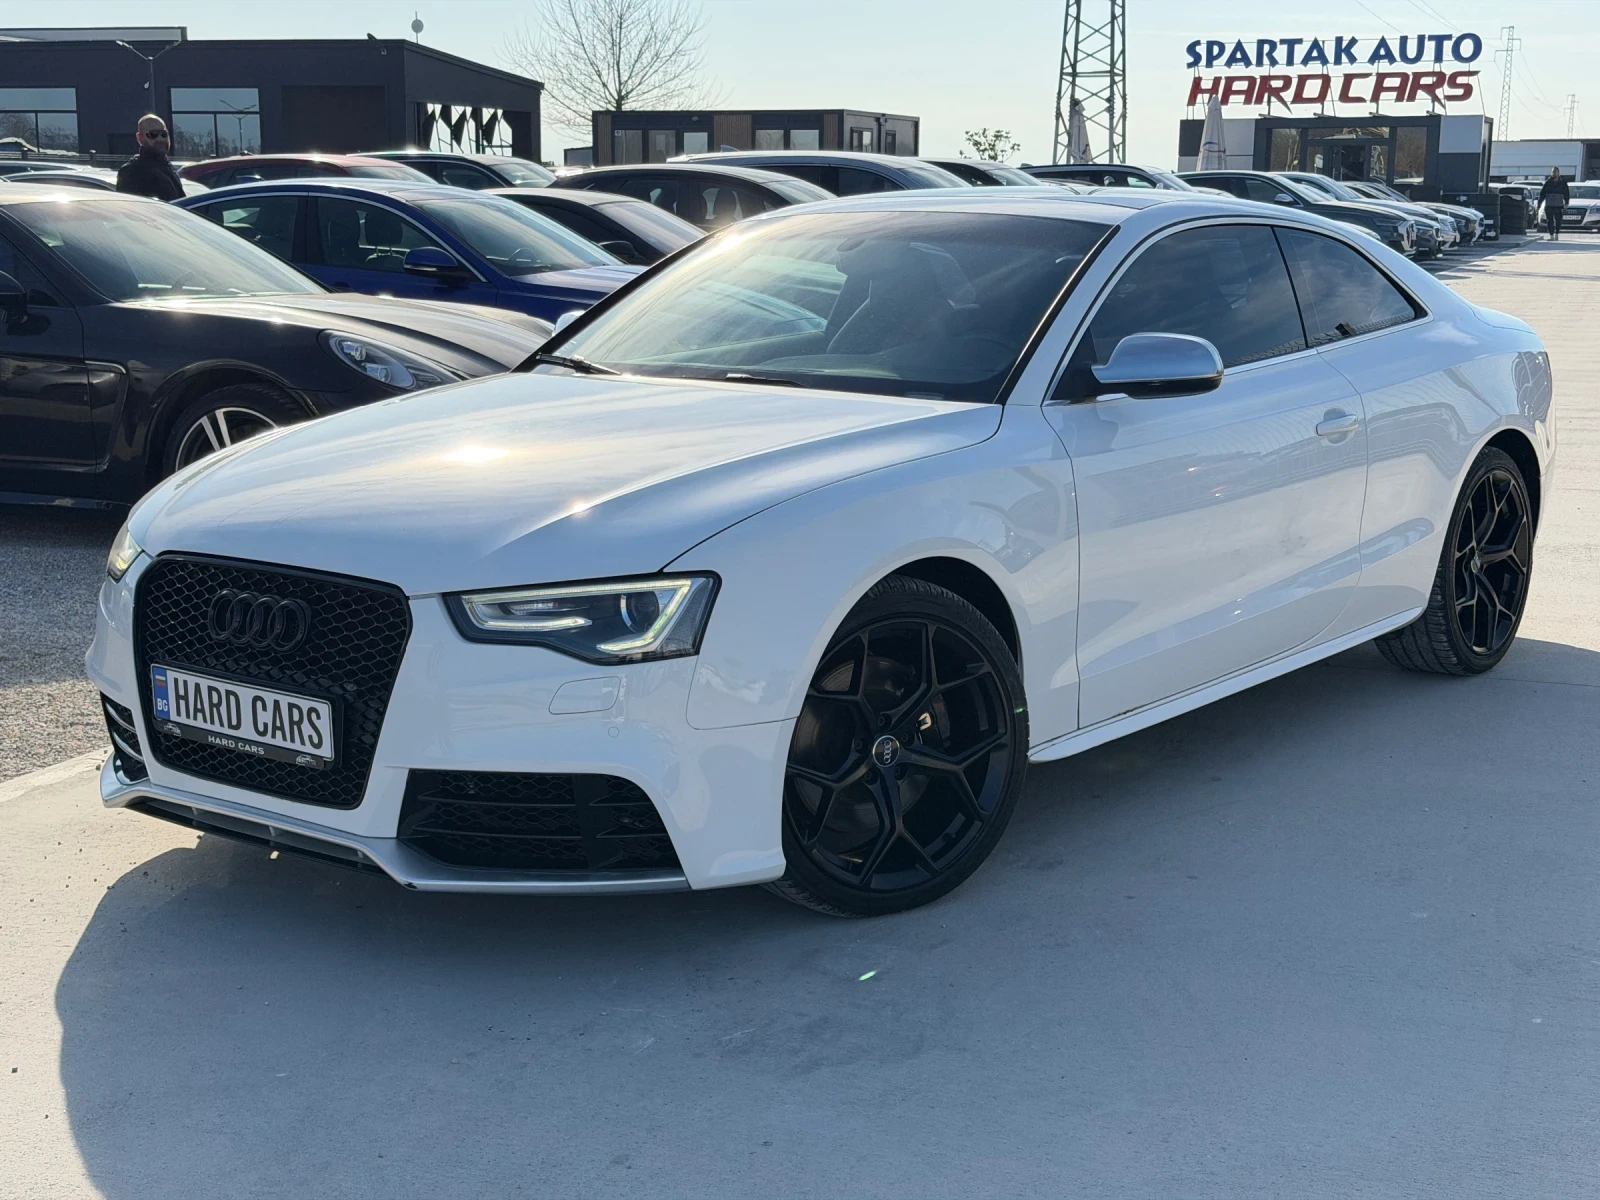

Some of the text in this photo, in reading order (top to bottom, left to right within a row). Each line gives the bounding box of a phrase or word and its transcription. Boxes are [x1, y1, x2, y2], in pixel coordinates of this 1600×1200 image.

[1186, 33, 1482, 69] SPARTAK AUTO
[1187, 70, 1481, 114] HARD CARS
[156, 698, 169, 711] BG
[173, 677, 323, 750] HARD CARS
[208, 735, 265, 755] HARD CARS
